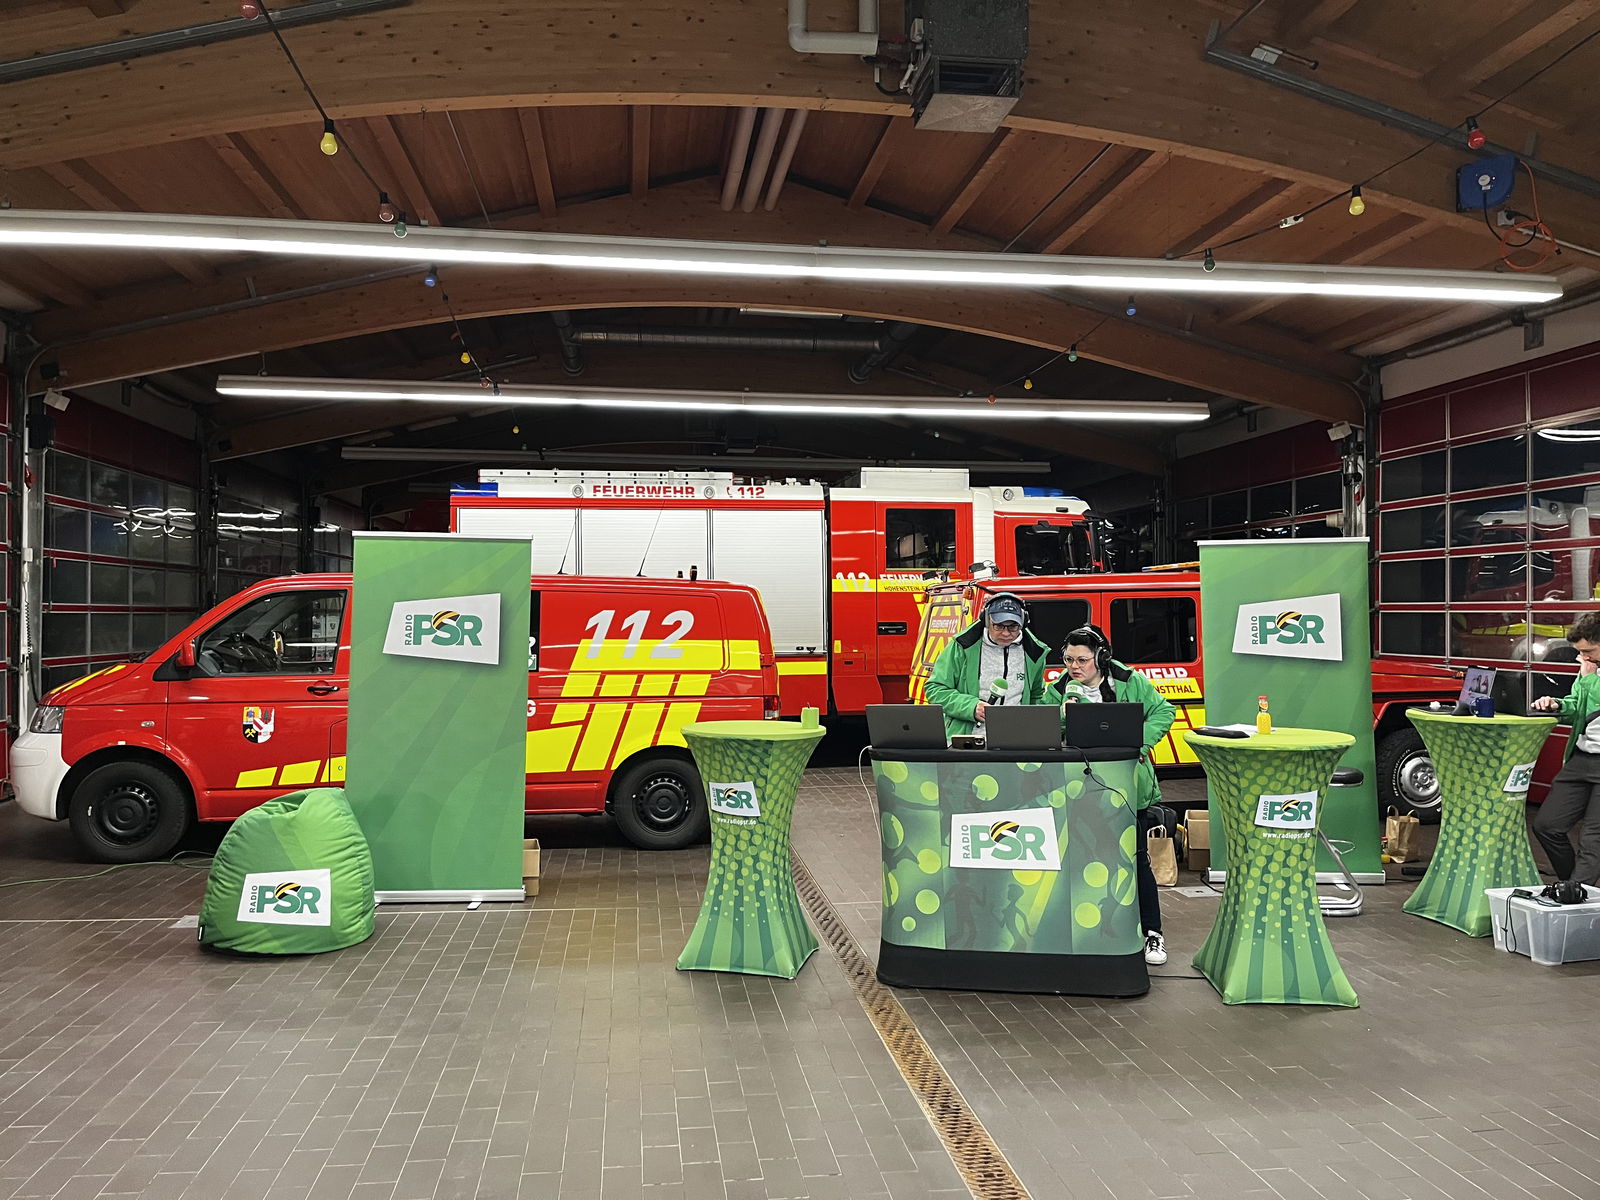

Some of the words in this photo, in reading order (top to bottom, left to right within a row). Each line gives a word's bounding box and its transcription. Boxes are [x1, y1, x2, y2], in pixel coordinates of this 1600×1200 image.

[593, 485, 695, 498] FEUERWEHR
[737, 486, 765, 498] 112
[835, 572, 873, 591] 112
[404, 614, 413, 646] RADIO
[412, 610, 483, 646] PSR
[585, 609, 695, 659] 112
[1250, 615, 1259, 645] RADIO
[1258, 611, 1325, 645] PSR
[715, 787, 754, 809] PSR
[1262, 800, 1270, 821] RADIO
[1268, 799, 1313, 822] PSR
[960, 824, 971, 859] RADIO
[969, 821, 1047, 861] PSR
[1262, 832, 1311, 840] www.radiopsr.de
[248, 885, 258, 913] RADIO
[256, 882, 321, 914] PSR
